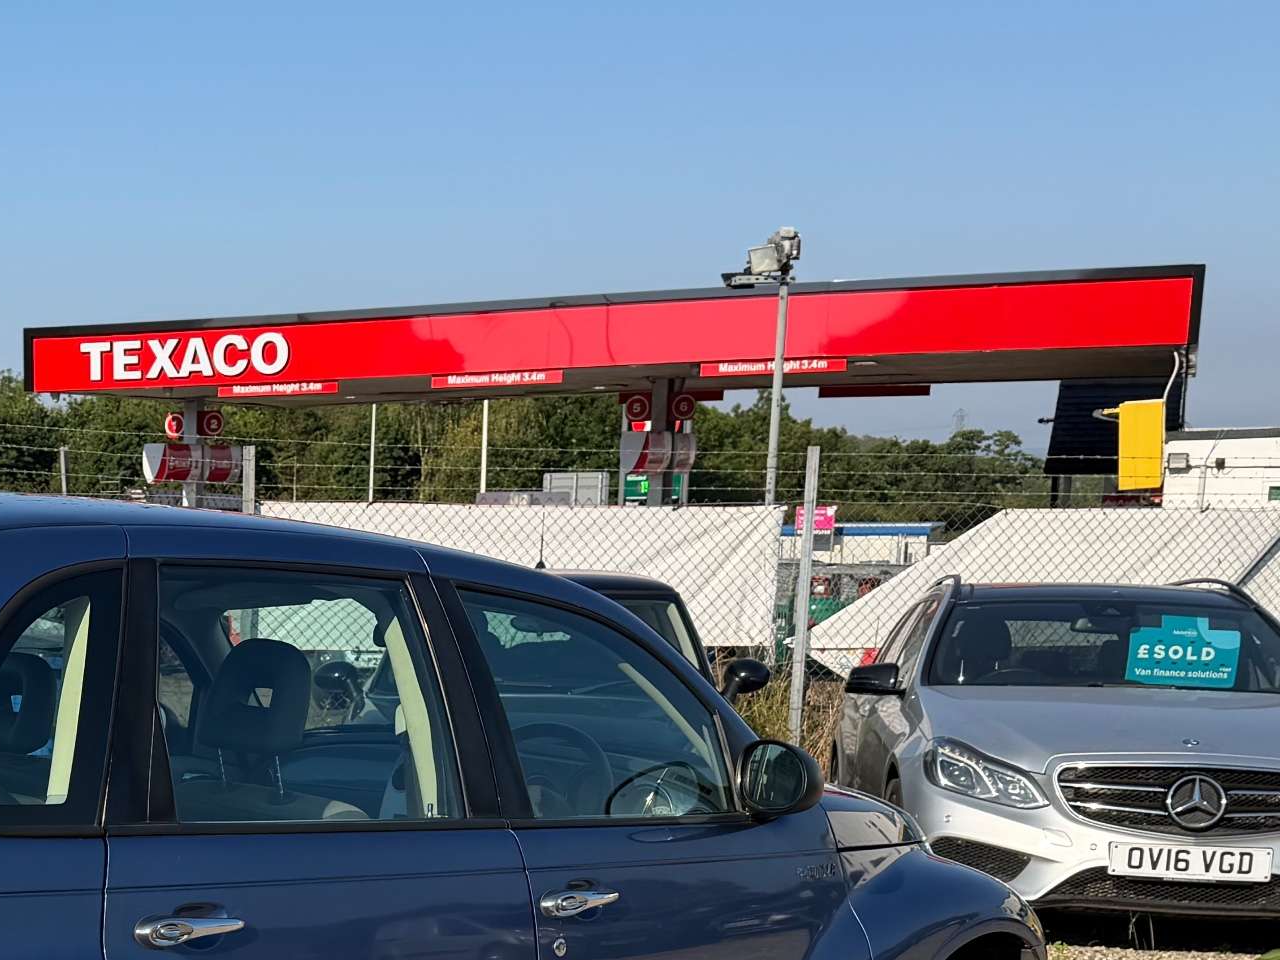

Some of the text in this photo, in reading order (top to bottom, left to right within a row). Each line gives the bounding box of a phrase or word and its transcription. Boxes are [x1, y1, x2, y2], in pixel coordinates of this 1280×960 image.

[80, 332, 289, 381] TEXACO
[718, 359, 827, 372] Maximum Hght 3.4m
[447, 371, 545, 384] Maximum Height 3.4m
[232, 382, 323, 394] Maximum Height 3.4m
[632, 403, 640, 413] 5
[679, 401, 688, 411] 6
[210, 419, 218, 429] 2
[1134, 667, 1228, 679] Van finance solutions
[1127, 847, 1253, 875] OV16 VGD
